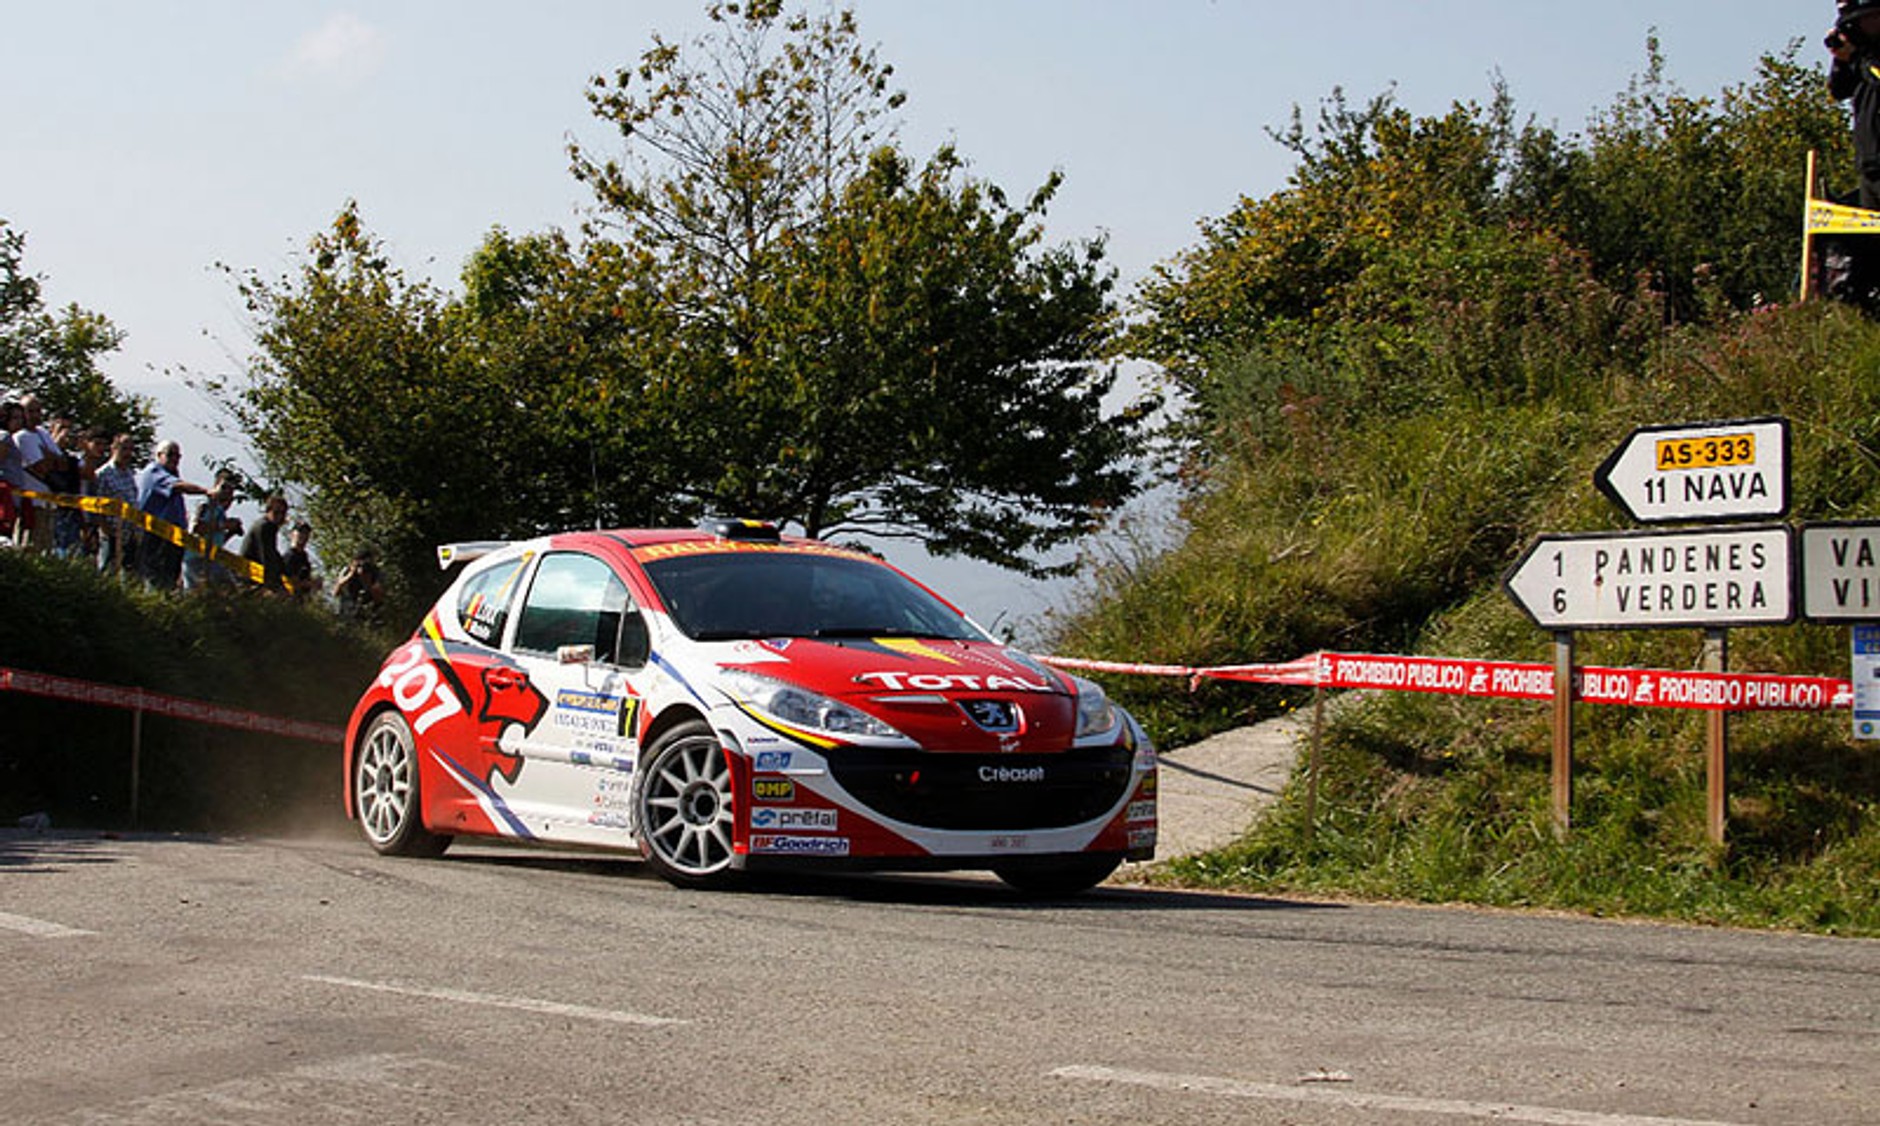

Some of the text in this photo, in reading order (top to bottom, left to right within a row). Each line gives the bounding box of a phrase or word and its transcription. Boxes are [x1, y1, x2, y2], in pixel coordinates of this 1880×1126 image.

[1660, 438, 1751, 466] AS-333
[1644, 471, 1768, 503] 11 NAVA
[1553, 543, 1767, 577] 1 PANDENES
[1832, 537, 1875, 568] VA
[1552, 581, 1767, 614] 6 VERDERA
[1832, 577, 1880, 608] VI
[379, 644, 463, 736] 207
[861, 671, 1055, 691] TOTAL
[1336, 660, 1464, 690] PROHIBIDO PUBLICO
[1492, 667, 1555, 695] PROHIBID
[1658, 676, 1741, 706] PROHIBIDO
[1745, 680, 1822, 709] PUBLICO
[624, 697, 637, 737] 7
[755, 782, 791, 796] OMP
[752, 836, 848, 851] BFGoodrich
